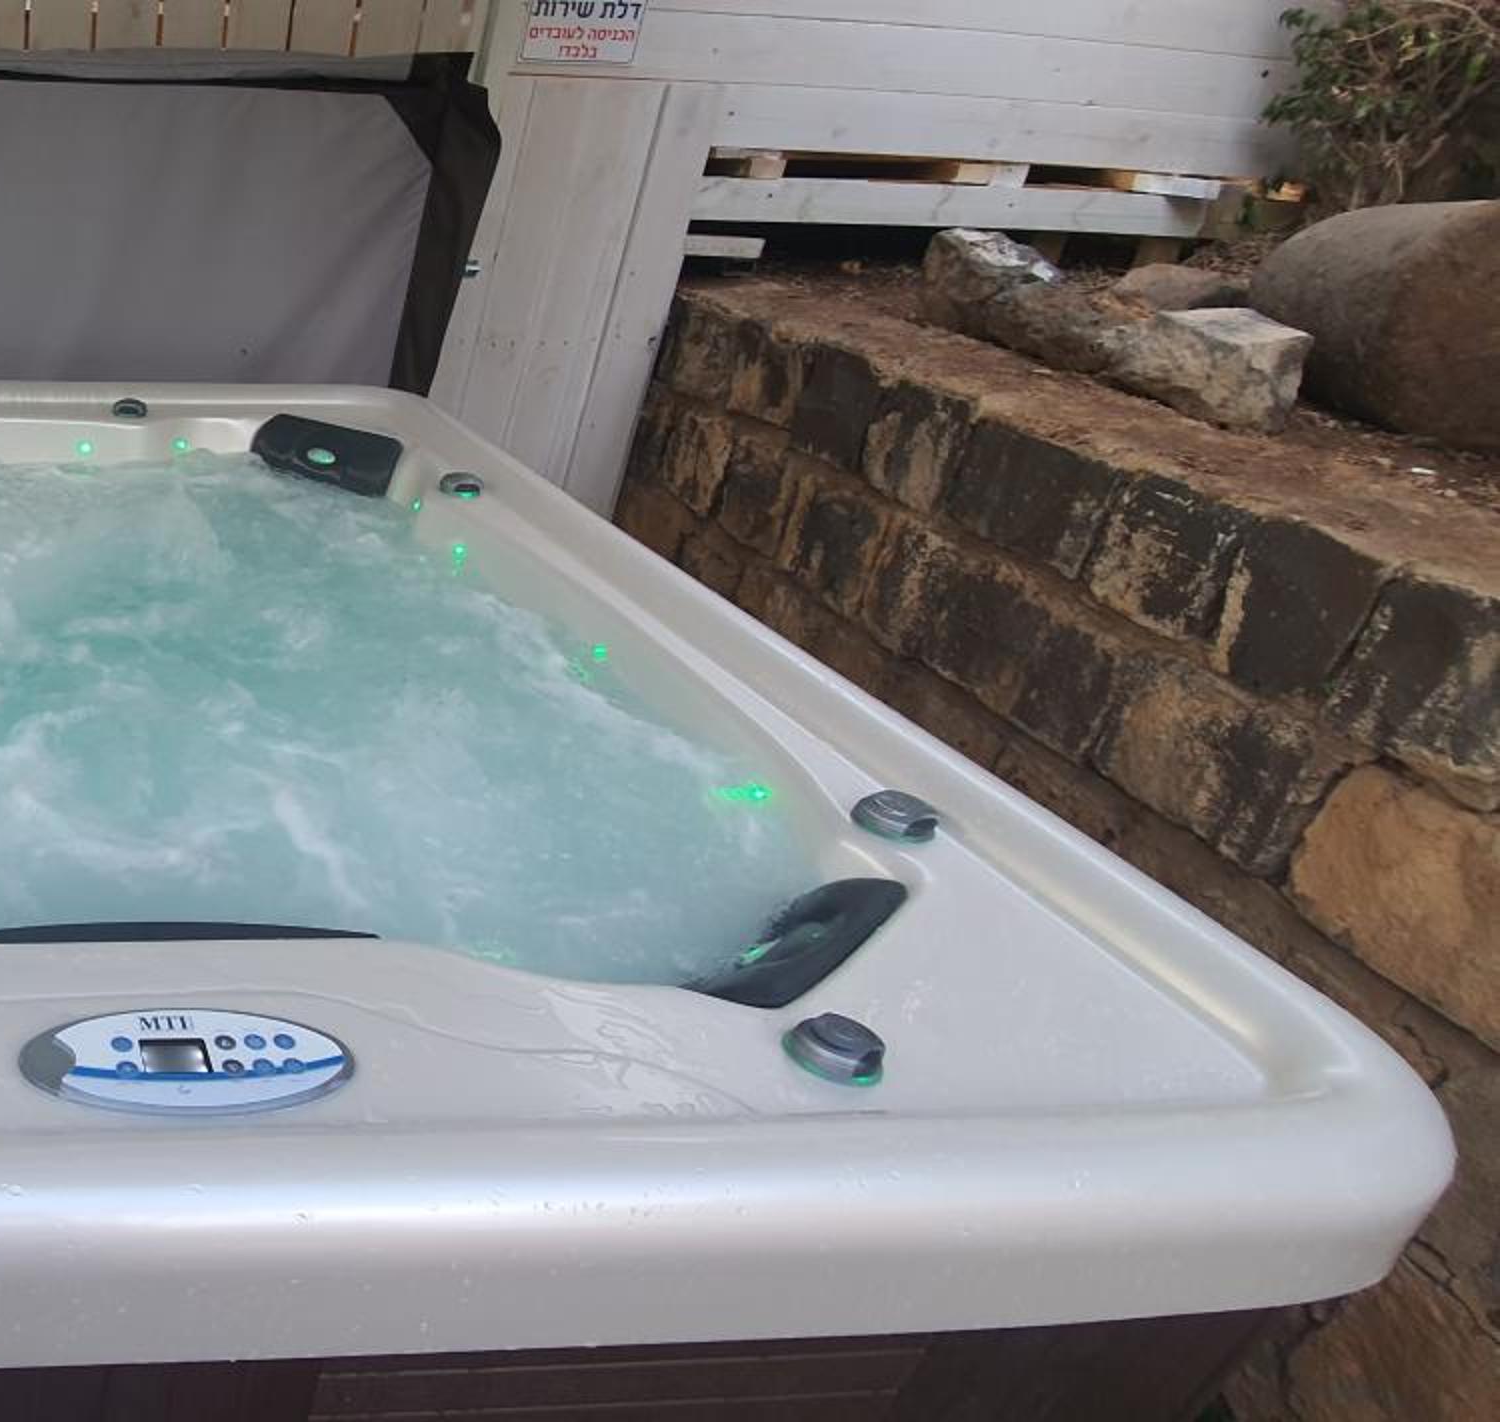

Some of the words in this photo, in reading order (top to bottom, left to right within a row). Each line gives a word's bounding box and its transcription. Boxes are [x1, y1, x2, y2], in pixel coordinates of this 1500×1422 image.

[532, 0, 594, 18] שירות
[599, 0, 642, 18] דלת
[529, 26, 585, 39] לעובדים
[587, 28, 635, 41] הכניסה
